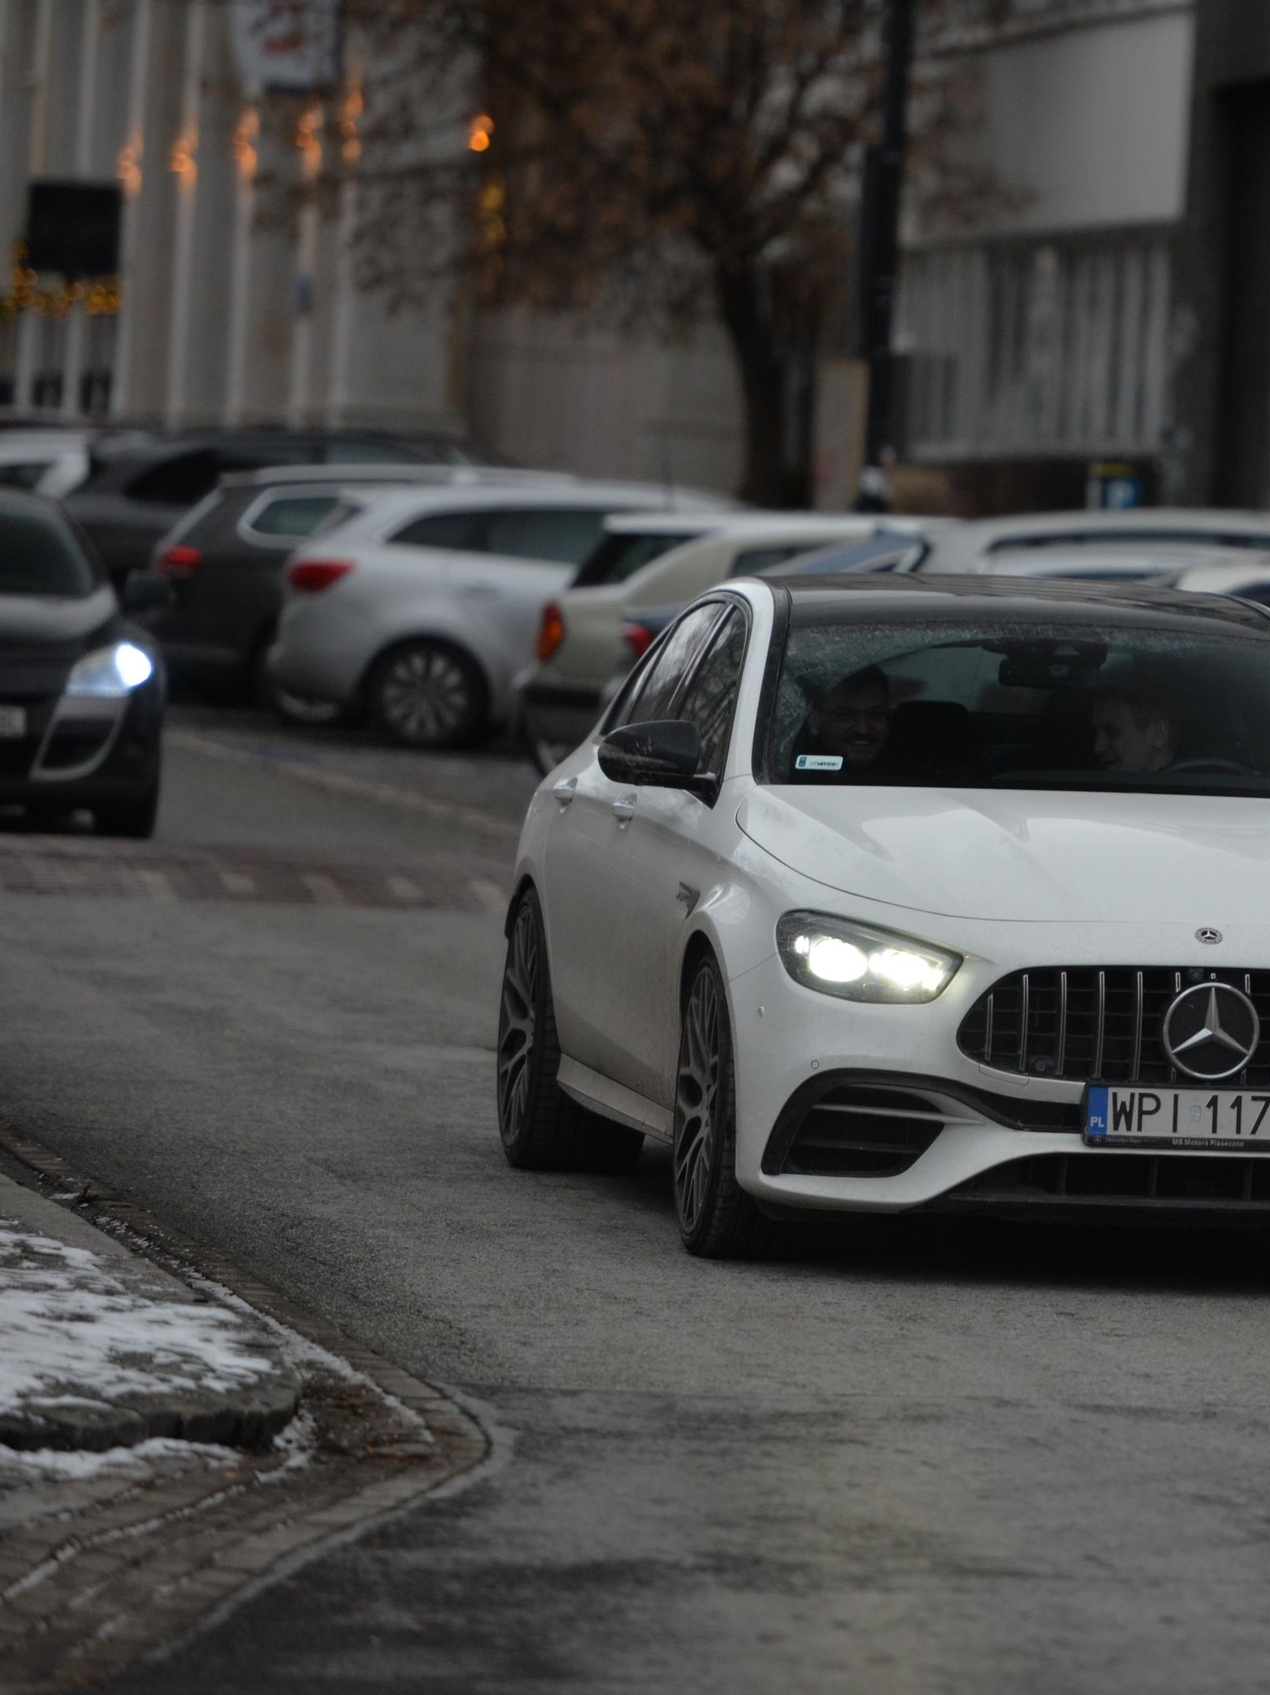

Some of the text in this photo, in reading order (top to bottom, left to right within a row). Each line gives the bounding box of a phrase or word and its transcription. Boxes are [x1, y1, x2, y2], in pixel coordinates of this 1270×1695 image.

[1111, 1091, 1180, 1134] WPI
[1089, 1116, 1105, 1128] PL
[1171, 1138, 1245, 1148] MB Motors Piaseczno
